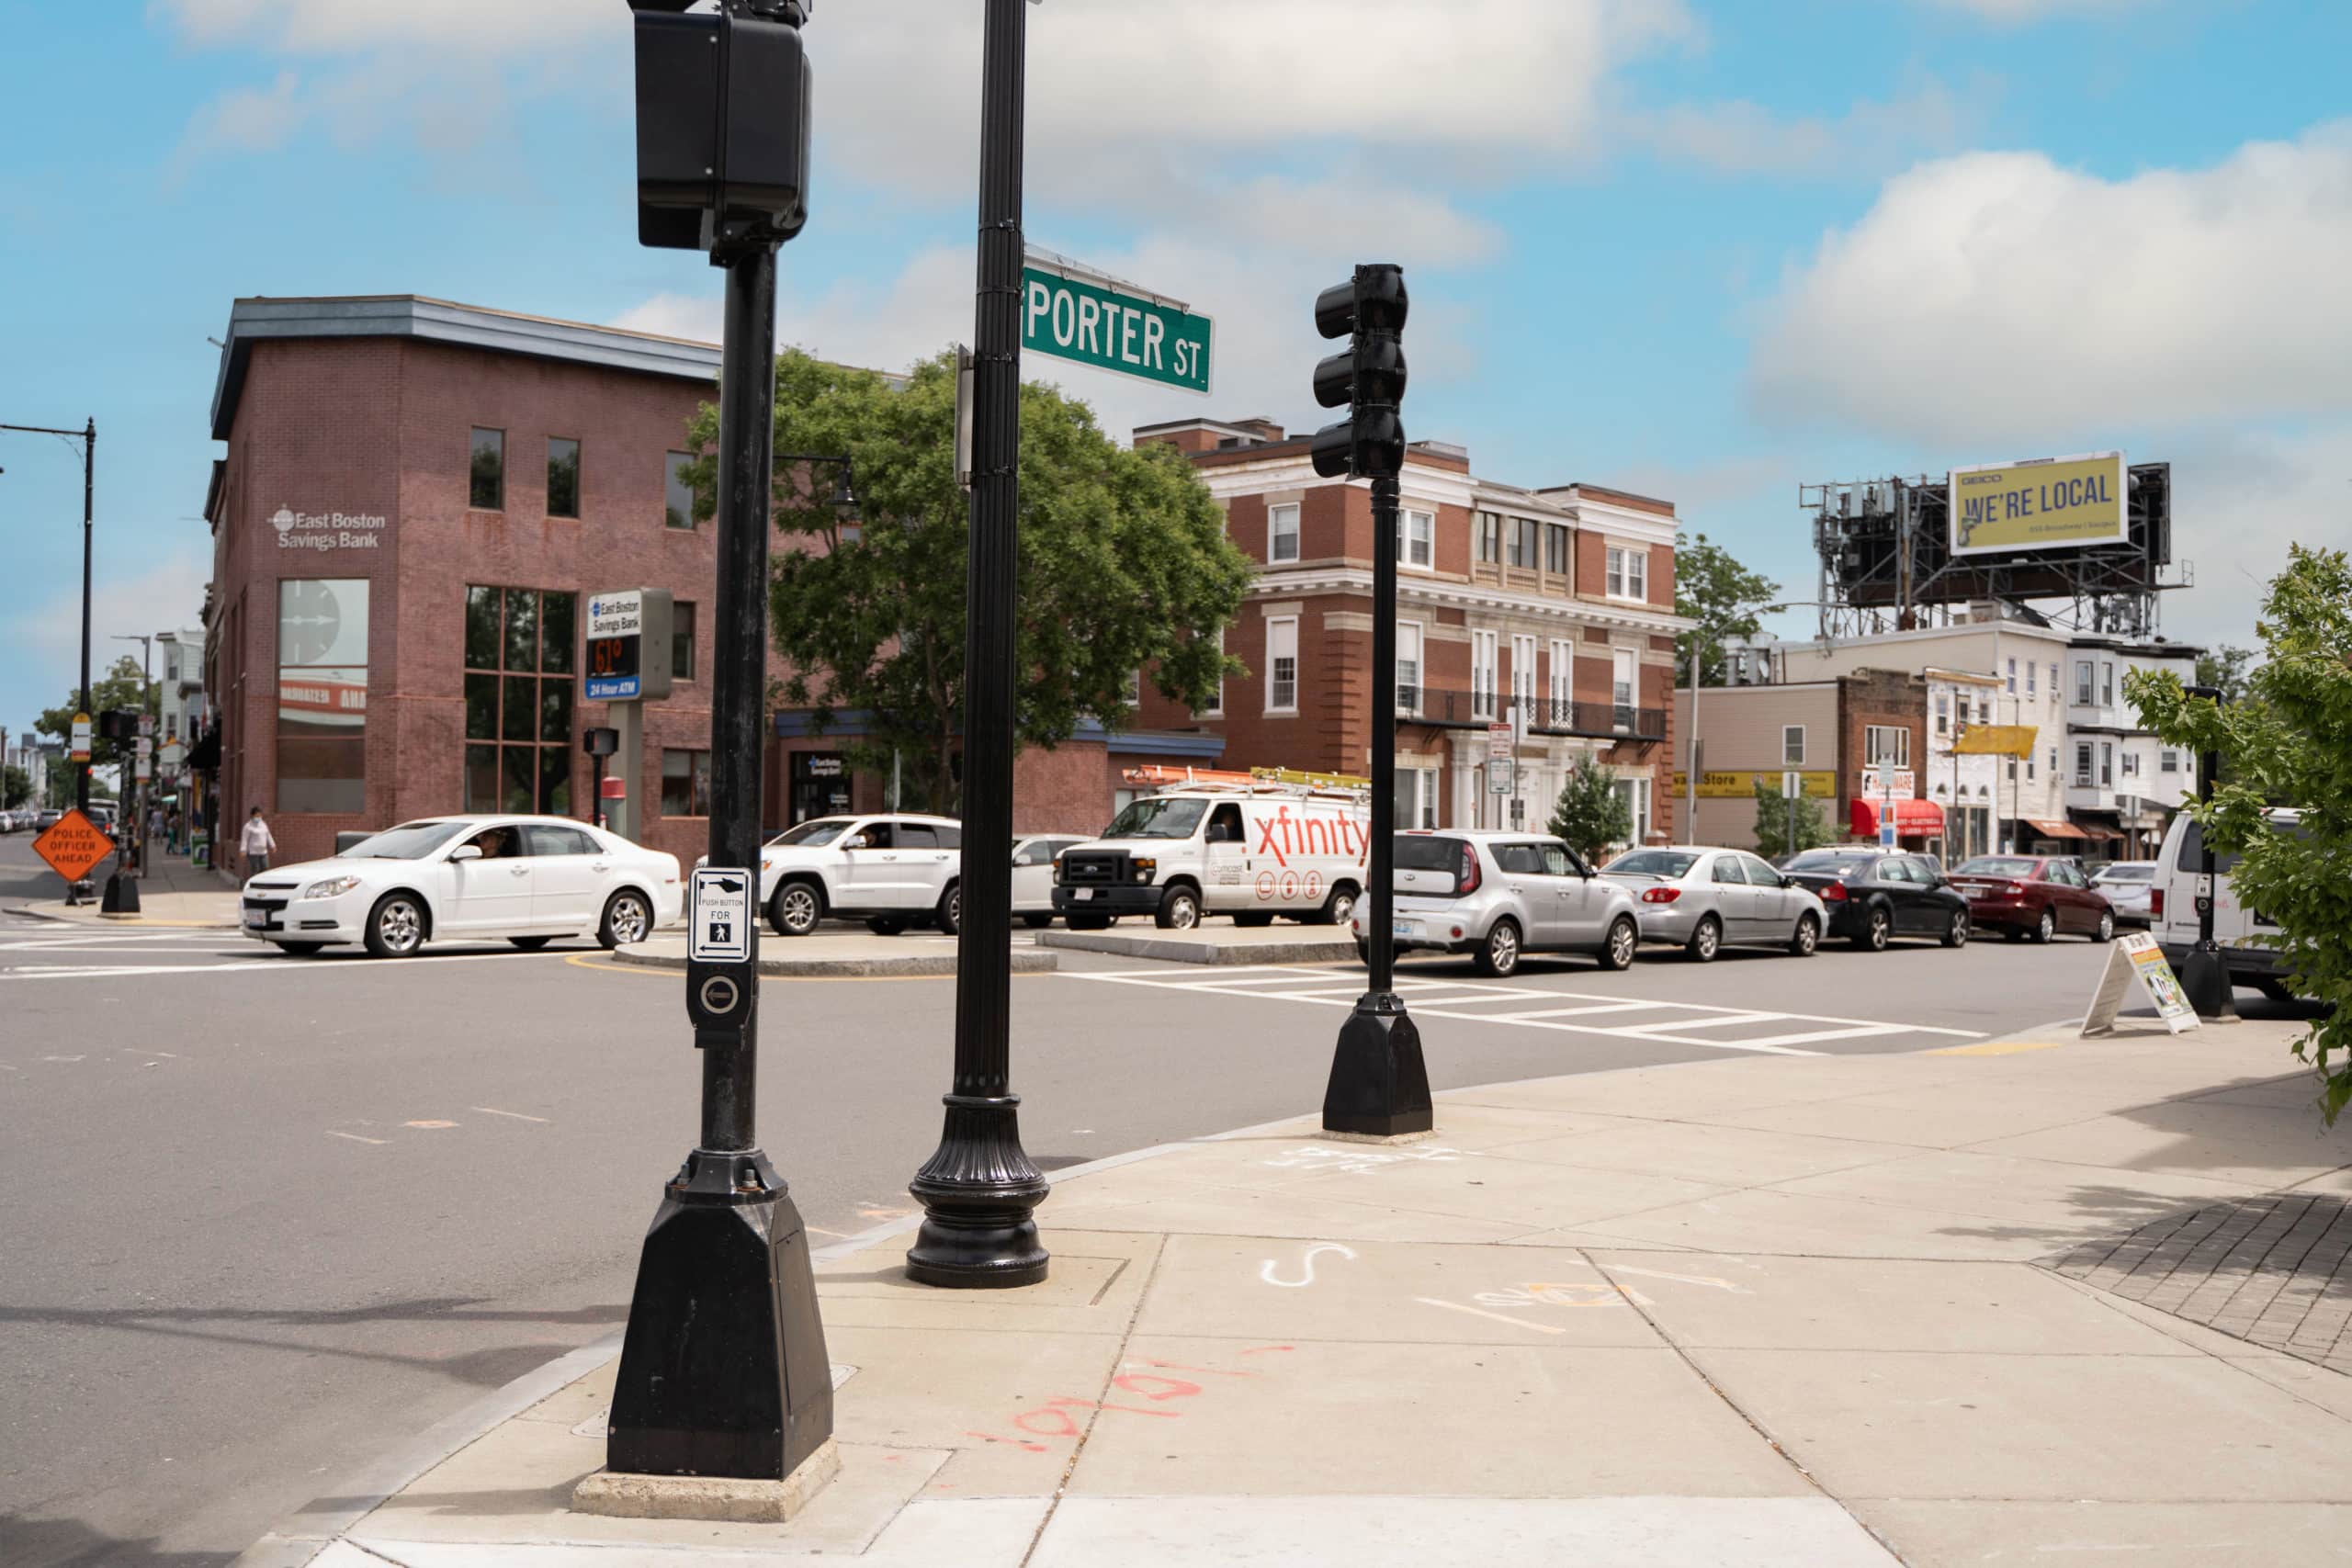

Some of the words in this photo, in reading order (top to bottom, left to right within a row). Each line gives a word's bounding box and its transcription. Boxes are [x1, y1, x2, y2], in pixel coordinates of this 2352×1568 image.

[1027, 280, 1164, 370] PORTER
[1964, 488, 2034, 525] WE'RE
[2041, 474, 2113, 513] LOCAL
[296, 512, 330, 529] East
[332, 512, 386, 529] Boston
[278, 532, 337, 551] Savings
[339, 532, 379, 547] Bank
[601, 603, 616, 615] East
[616, 601, 639, 615] Boston
[594, 618, 620, 634] Savings
[621, 616, 639, 630] Bank
[590, 683, 601, 697] 24
[601, 682, 618, 695] Hour
[618, 681, 637, 694] ATM
[1703, 773, 1736, 786] Store
[53, 829, 92, 838] POLICE
[1255, 805, 1371, 868] xfinity
[50, 840, 96, 852] OFFICER
[53, 854, 92, 863] AHEAD
[702, 898, 719, 907] PUSH
[720, 898, 743, 907] BUTTON
[711, 910, 730, 919] FOR
